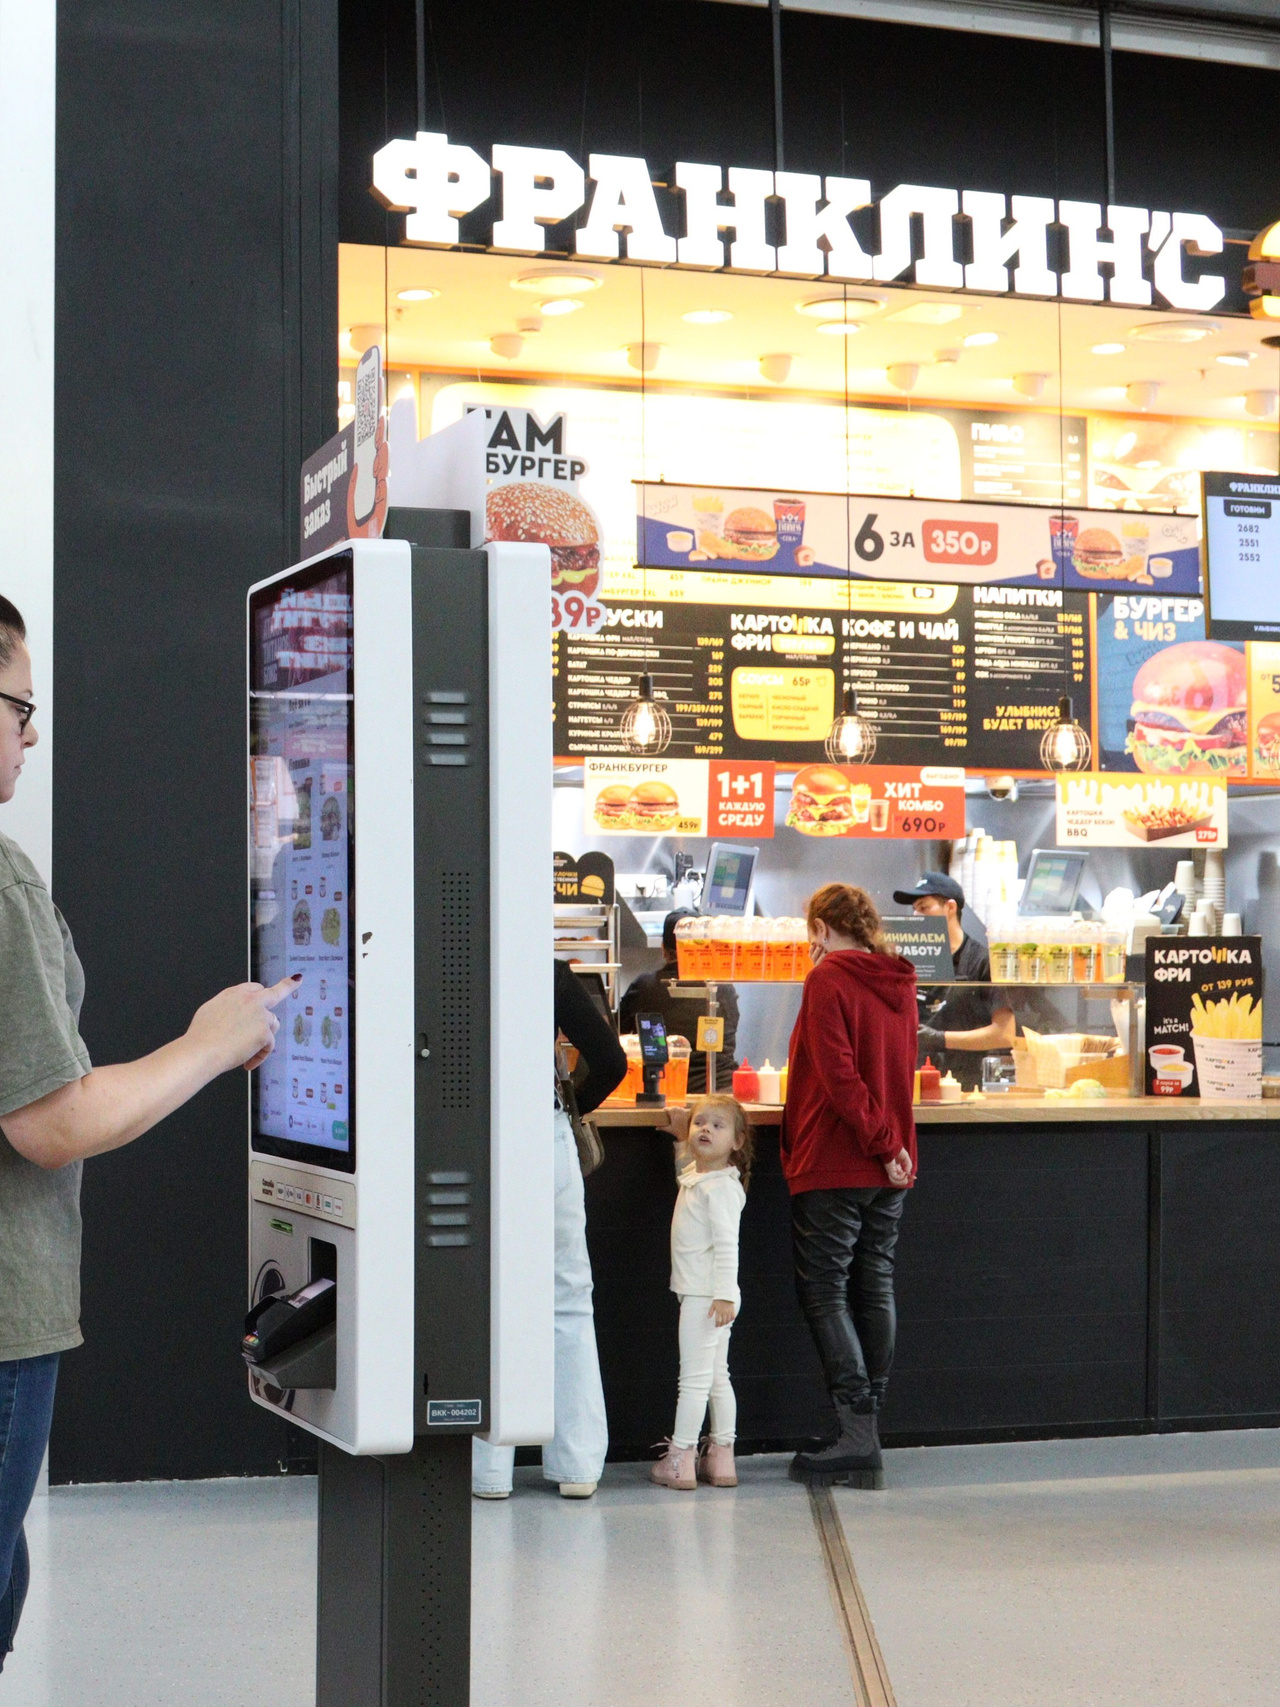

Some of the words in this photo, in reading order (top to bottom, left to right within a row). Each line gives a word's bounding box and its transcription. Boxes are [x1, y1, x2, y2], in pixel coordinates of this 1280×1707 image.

[971, 422, 1024, 444] ПИВО
[303, 439, 348, 505] Быстрый
[485, 452, 586, 482] БУРГЕР
[1230, 504, 1266, 515] ГОТОВИМ
[303, 499, 331, 540] заказ
[1237, 523, 1260, 534] 2682
[854, 513, 885, 562] 6
[889, 531, 916, 549] ЗА
[1239, 538, 1260, 548] 2551
[1238, 552, 1261, 563] 2552
[973, 585, 1063, 608] НАПИТКИ
[1113, 595, 1204, 623] БУРГЕР
[605, 608, 664, 629] УСКИ
[730, 613, 834, 636] КАРТОШКА
[842, 618, 896, 639] КОФЕ
[899, 622, 915, 639] И
[918, 619, 960, 641] ЧАЙ
[1133, 621, 1177, 642] ЧИЗ
[567, 634, 605, 643] КАРТОШКА
[605, 635, 621, 643] ФРИ
[730, 633, 772, 652] ФРИ
[567, 647, 605, 656] КАРТОШКА
[567, 660, 588, 669] БАТАТ
[567, 674, 605, 684] КАРТОШКА
[605, 676, 631, 685] ЧЕДДЕР
[738, 672, 784, 687] СОУСЫ
[974, 671, 990, 680] СОК
[567, 688, 605, 698] КАРТОШКА
[605, 690, 631, 698] ЧЕДДЕР
[567, 702, 602, 711] СТРИПСЫ
[568, 716, 603, 725] НАГГЕТСЫ
[982, 718, 1024, 731] БУДЕТ
[568, 730, 600, 739] КУРИНЫЕ
[568, 744, 598, 753] СЫРНЫЕ
[588, 761, 668, 774] ФРАНКБУРГЕР
[716, 771, 763, 798] 1+1
[883, 782, 923, 799] ХИТ
[718, 801, 766, 812] КАЖДУЮ
[898, 800, 944, 813] КОМБО
[718, 813, 765, 828] СРЕДУ
[1067, 818, 1092, 826] ЧЕДДЕР
[1067, 828, 1089, 838] BBQ
[1154, 946, 1252, 965] КАРТОШКА
[1154, 967, 1191, 982] ФРИ
[1201, 983, 1213, 992] ОТ
[1217, 980, 1232, 990] 139
[1235, 977, 1254, 987] РУБ
[1154, 1024, 1190, 1035] MATCH!
